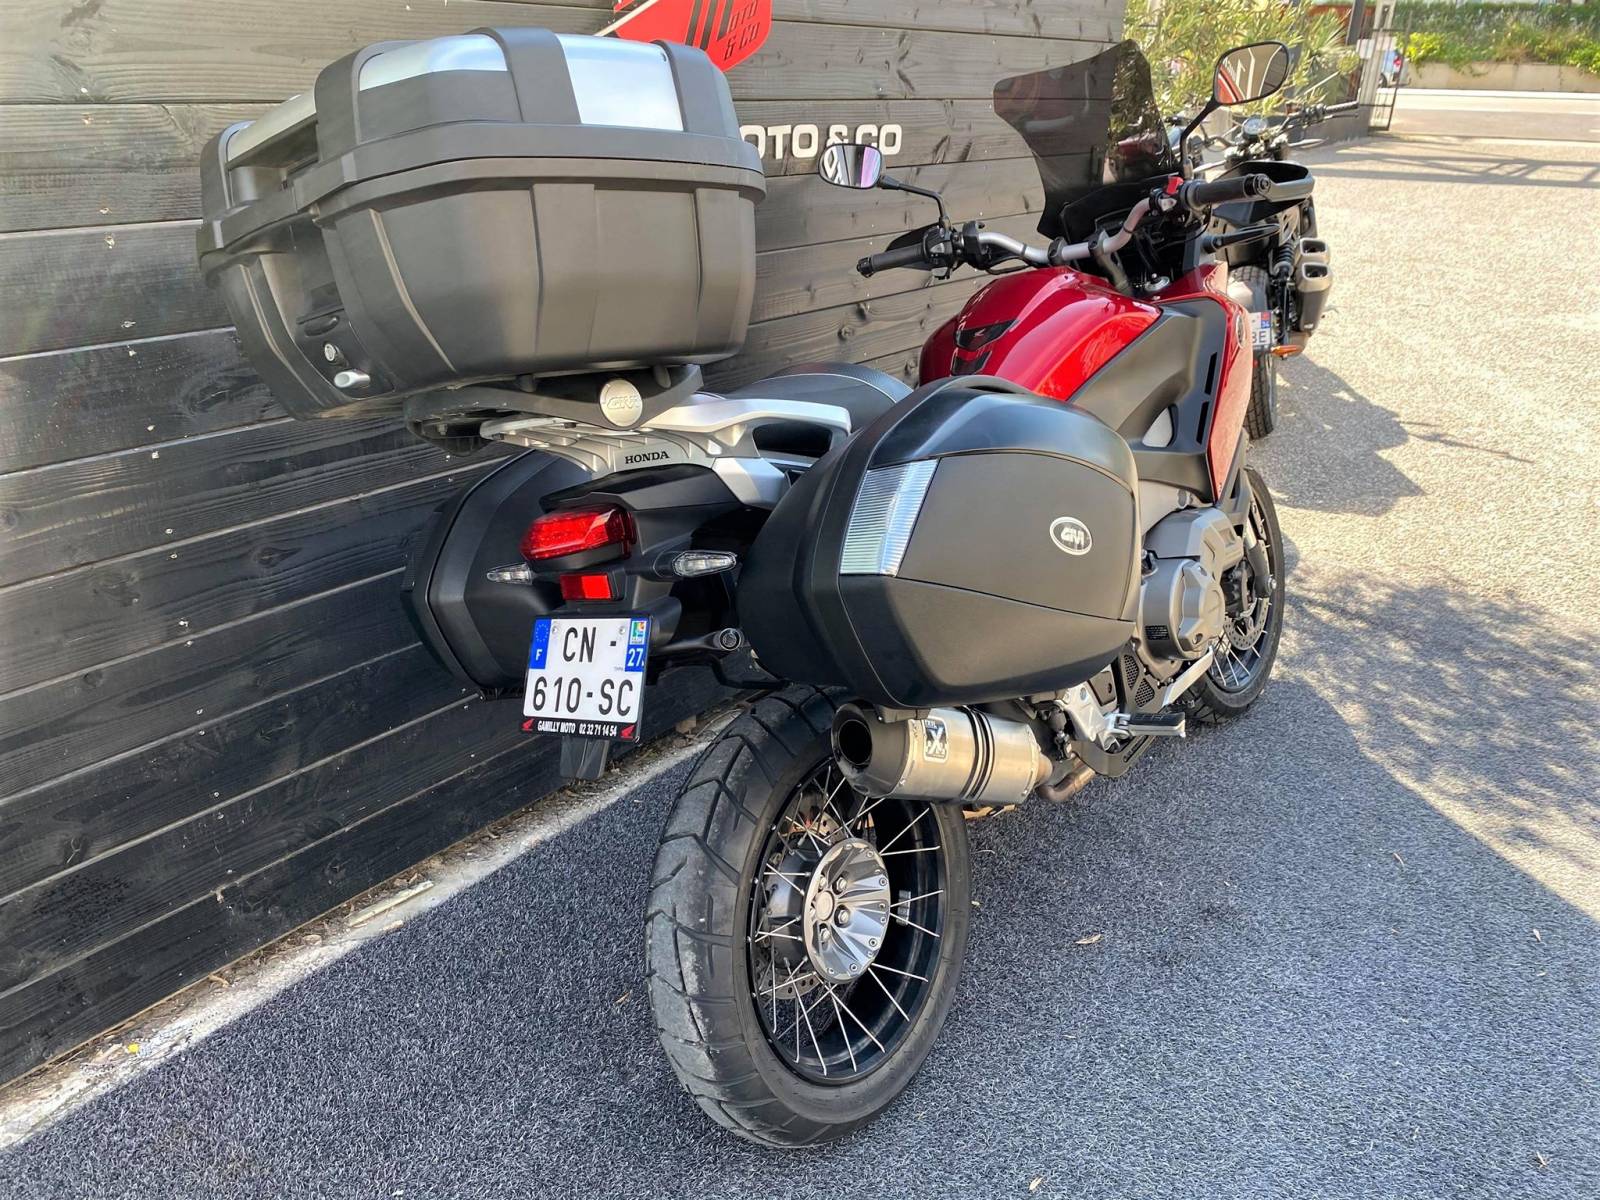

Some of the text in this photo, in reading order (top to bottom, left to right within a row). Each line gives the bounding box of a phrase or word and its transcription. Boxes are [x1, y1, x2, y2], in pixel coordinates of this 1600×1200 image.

[740, 124, 818, 160] OTO
[855, 124, 902, 155] CO
[625, 450, 670, 464] HONDA
[563, 626, 597, 662] CN
[535, 649, 543, 661] F
[627, 648, 643, 667] 27
[532, 676, 633, 717] 610-SC
[538, 720, 617, 737] GAMILLY MOTO 02 32 71 14 54
